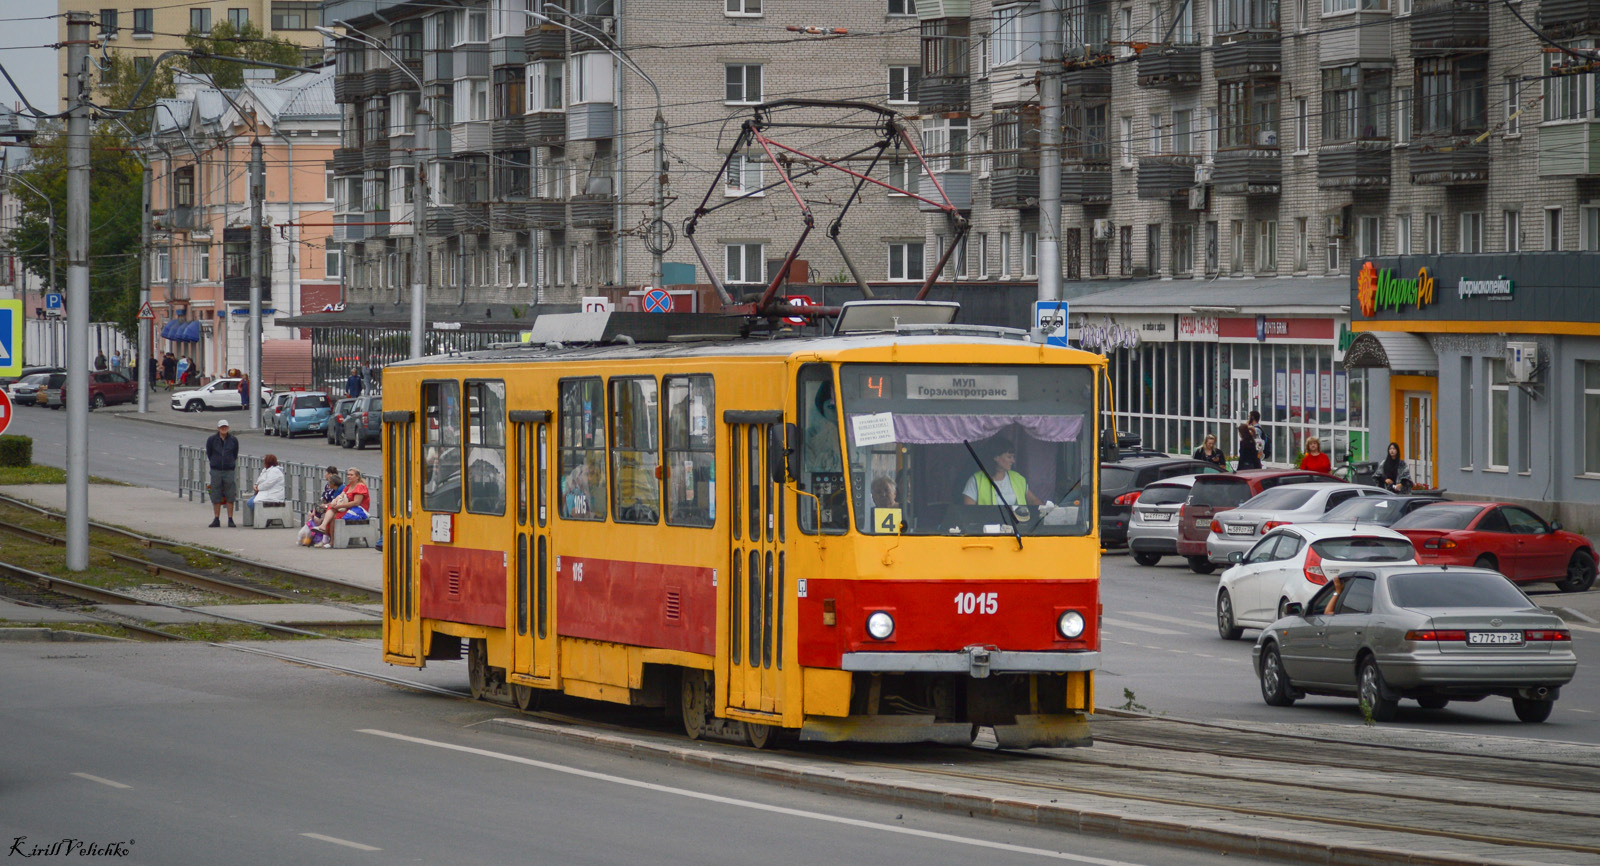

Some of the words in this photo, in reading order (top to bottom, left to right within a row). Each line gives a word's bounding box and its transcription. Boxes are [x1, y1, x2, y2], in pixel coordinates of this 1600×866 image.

[1458, 275, 1512, 300] фармакопейка
[49, 295, 59, 307] P
[1276, 321, 1288, 334] БАНК
[867, 376, 883, 398] 4
[918, 386, 1007, 397] Горэлектротранс
[952, 377, 976, 387] МУП
[573, 495, 587, 515] 1015
[881, 513, 896, 532] 4
[572, 562, 583, 582] 1015
[954, 592, 998, 614] 1015
[1510, 633, 1519, 641] 22
